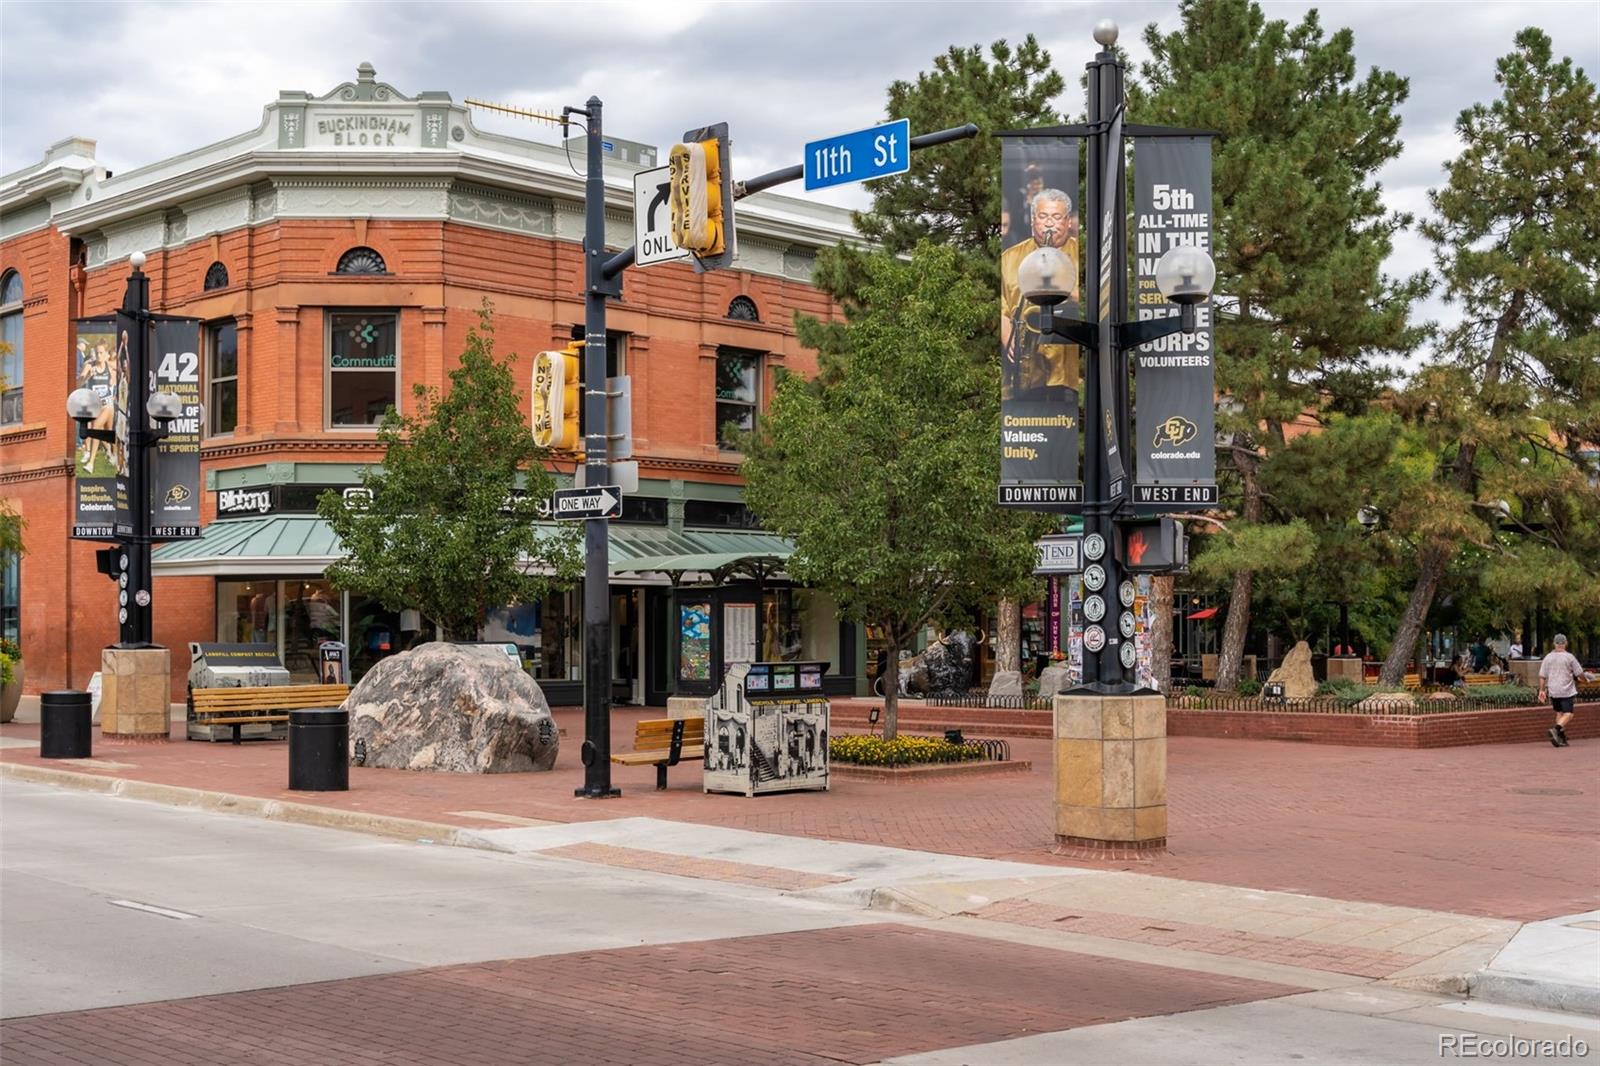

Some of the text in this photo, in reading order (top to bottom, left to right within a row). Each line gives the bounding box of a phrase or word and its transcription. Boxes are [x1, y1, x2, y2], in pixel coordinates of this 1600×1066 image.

[318, 116, 412, 136] BUCKINGHAM
[334, 132, 396, 147] BLOCK
[815, 133, 897, 180] 11th St
[1152, 184, 1194, 211] 5th
[1138, 213, 1209, 229] ALL-TIME
[642, 235, 679, 257] ONL
[1137, 231, 1209, 254] IN THE
[1138, 280, 1156, 290] FOR
[1138, 308, 1210, 328] PEE
[157, 352, 199, 383] 42
[331, 353, 397, 368] Commutif
[1139, 356, 1210, 368] VOLUNTEERS
[157, 384, 199, 394] NATIONAL
[186, 406, 199, 417] OF
[158, 418, 199, 434] AME
[1003, 415, 1076, 429] Community.
[1004, 430, 1048, 442] Values.
[169, 445, 200, 453] SPORTS
[1004, 446, 1038, 460] Unity.
[1151, 451, 1201, 459] colorado.edu
[1005, 487, 1077, 502] DOWNTOWN
[1141, 487, 1210, 502] WEST END
[80, 503, 116, 511] Celebrate.
[561, 498, 579, 511] ONE
[582, 496, 601, 510] WAY
[76, 527, 113, 536] DOWNTOW
[155, 527, 197, 536] WEST END
[1051, 546, 1074, 558] END
